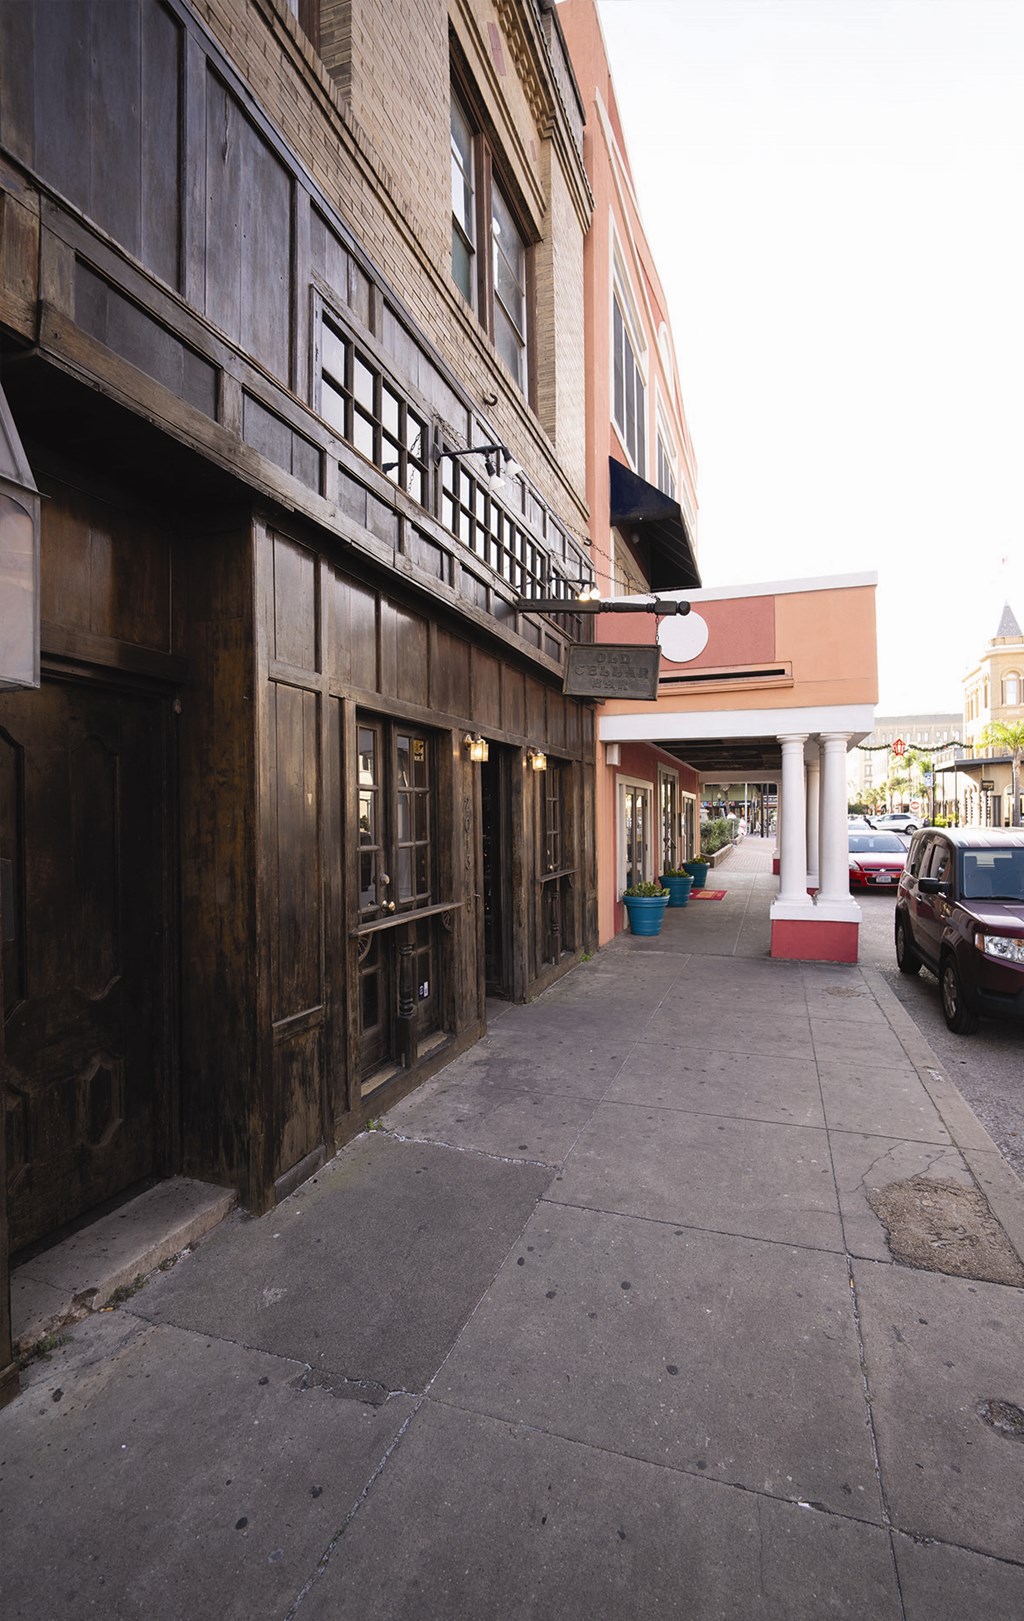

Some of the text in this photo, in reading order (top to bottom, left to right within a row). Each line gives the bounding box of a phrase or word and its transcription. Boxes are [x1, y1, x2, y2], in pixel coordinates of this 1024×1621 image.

[597, 653, 631, 665] OLD
[575, 664, 649, 679] CELLAR
[592, 678, 629, 691] BAR
